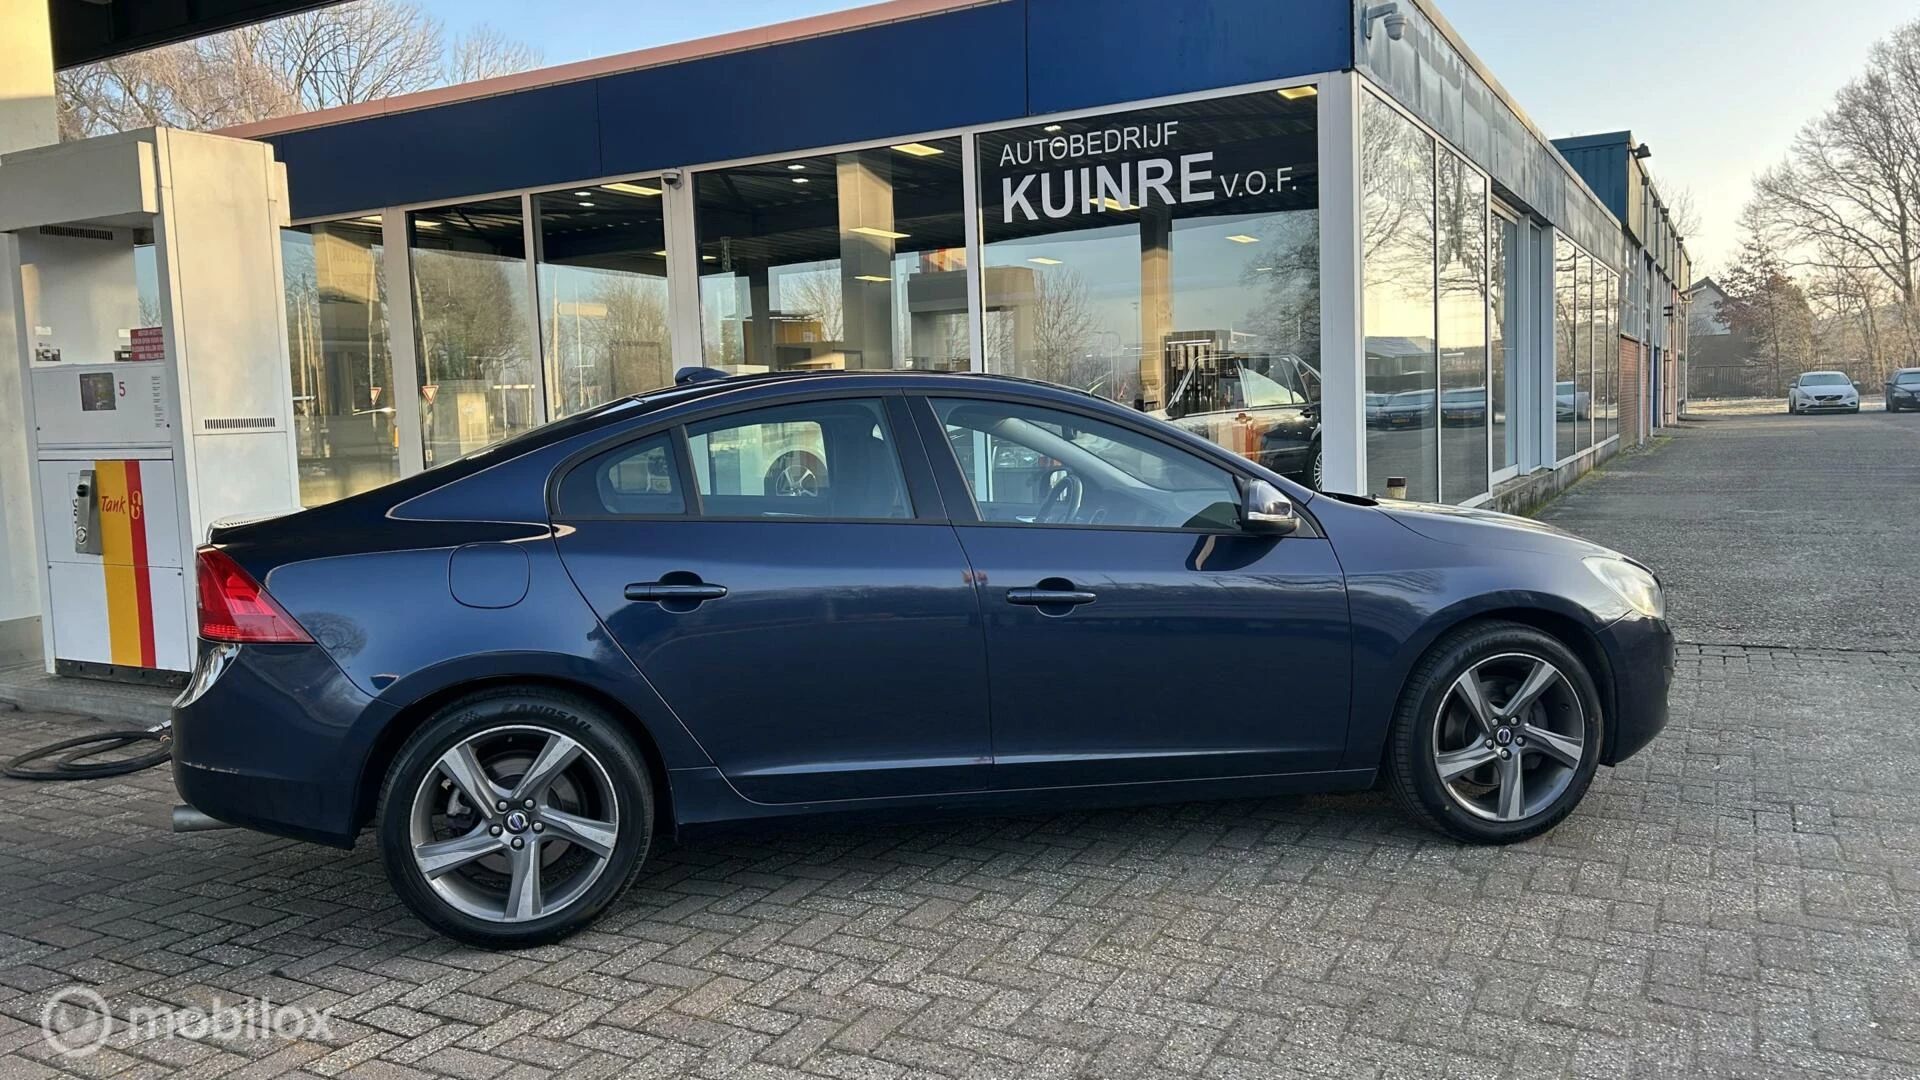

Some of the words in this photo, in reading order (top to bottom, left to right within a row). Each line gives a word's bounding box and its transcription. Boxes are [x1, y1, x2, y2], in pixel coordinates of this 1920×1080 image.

[1000, 121, 1179, 167] AUTOBEDRIJF
[1002, 151, 1215, 224] KUINRE
[1220, 167, 1298, 198] V.O.F.
[118, 381, 126, 397] 5
[101, 495, 126, 514] Tank
